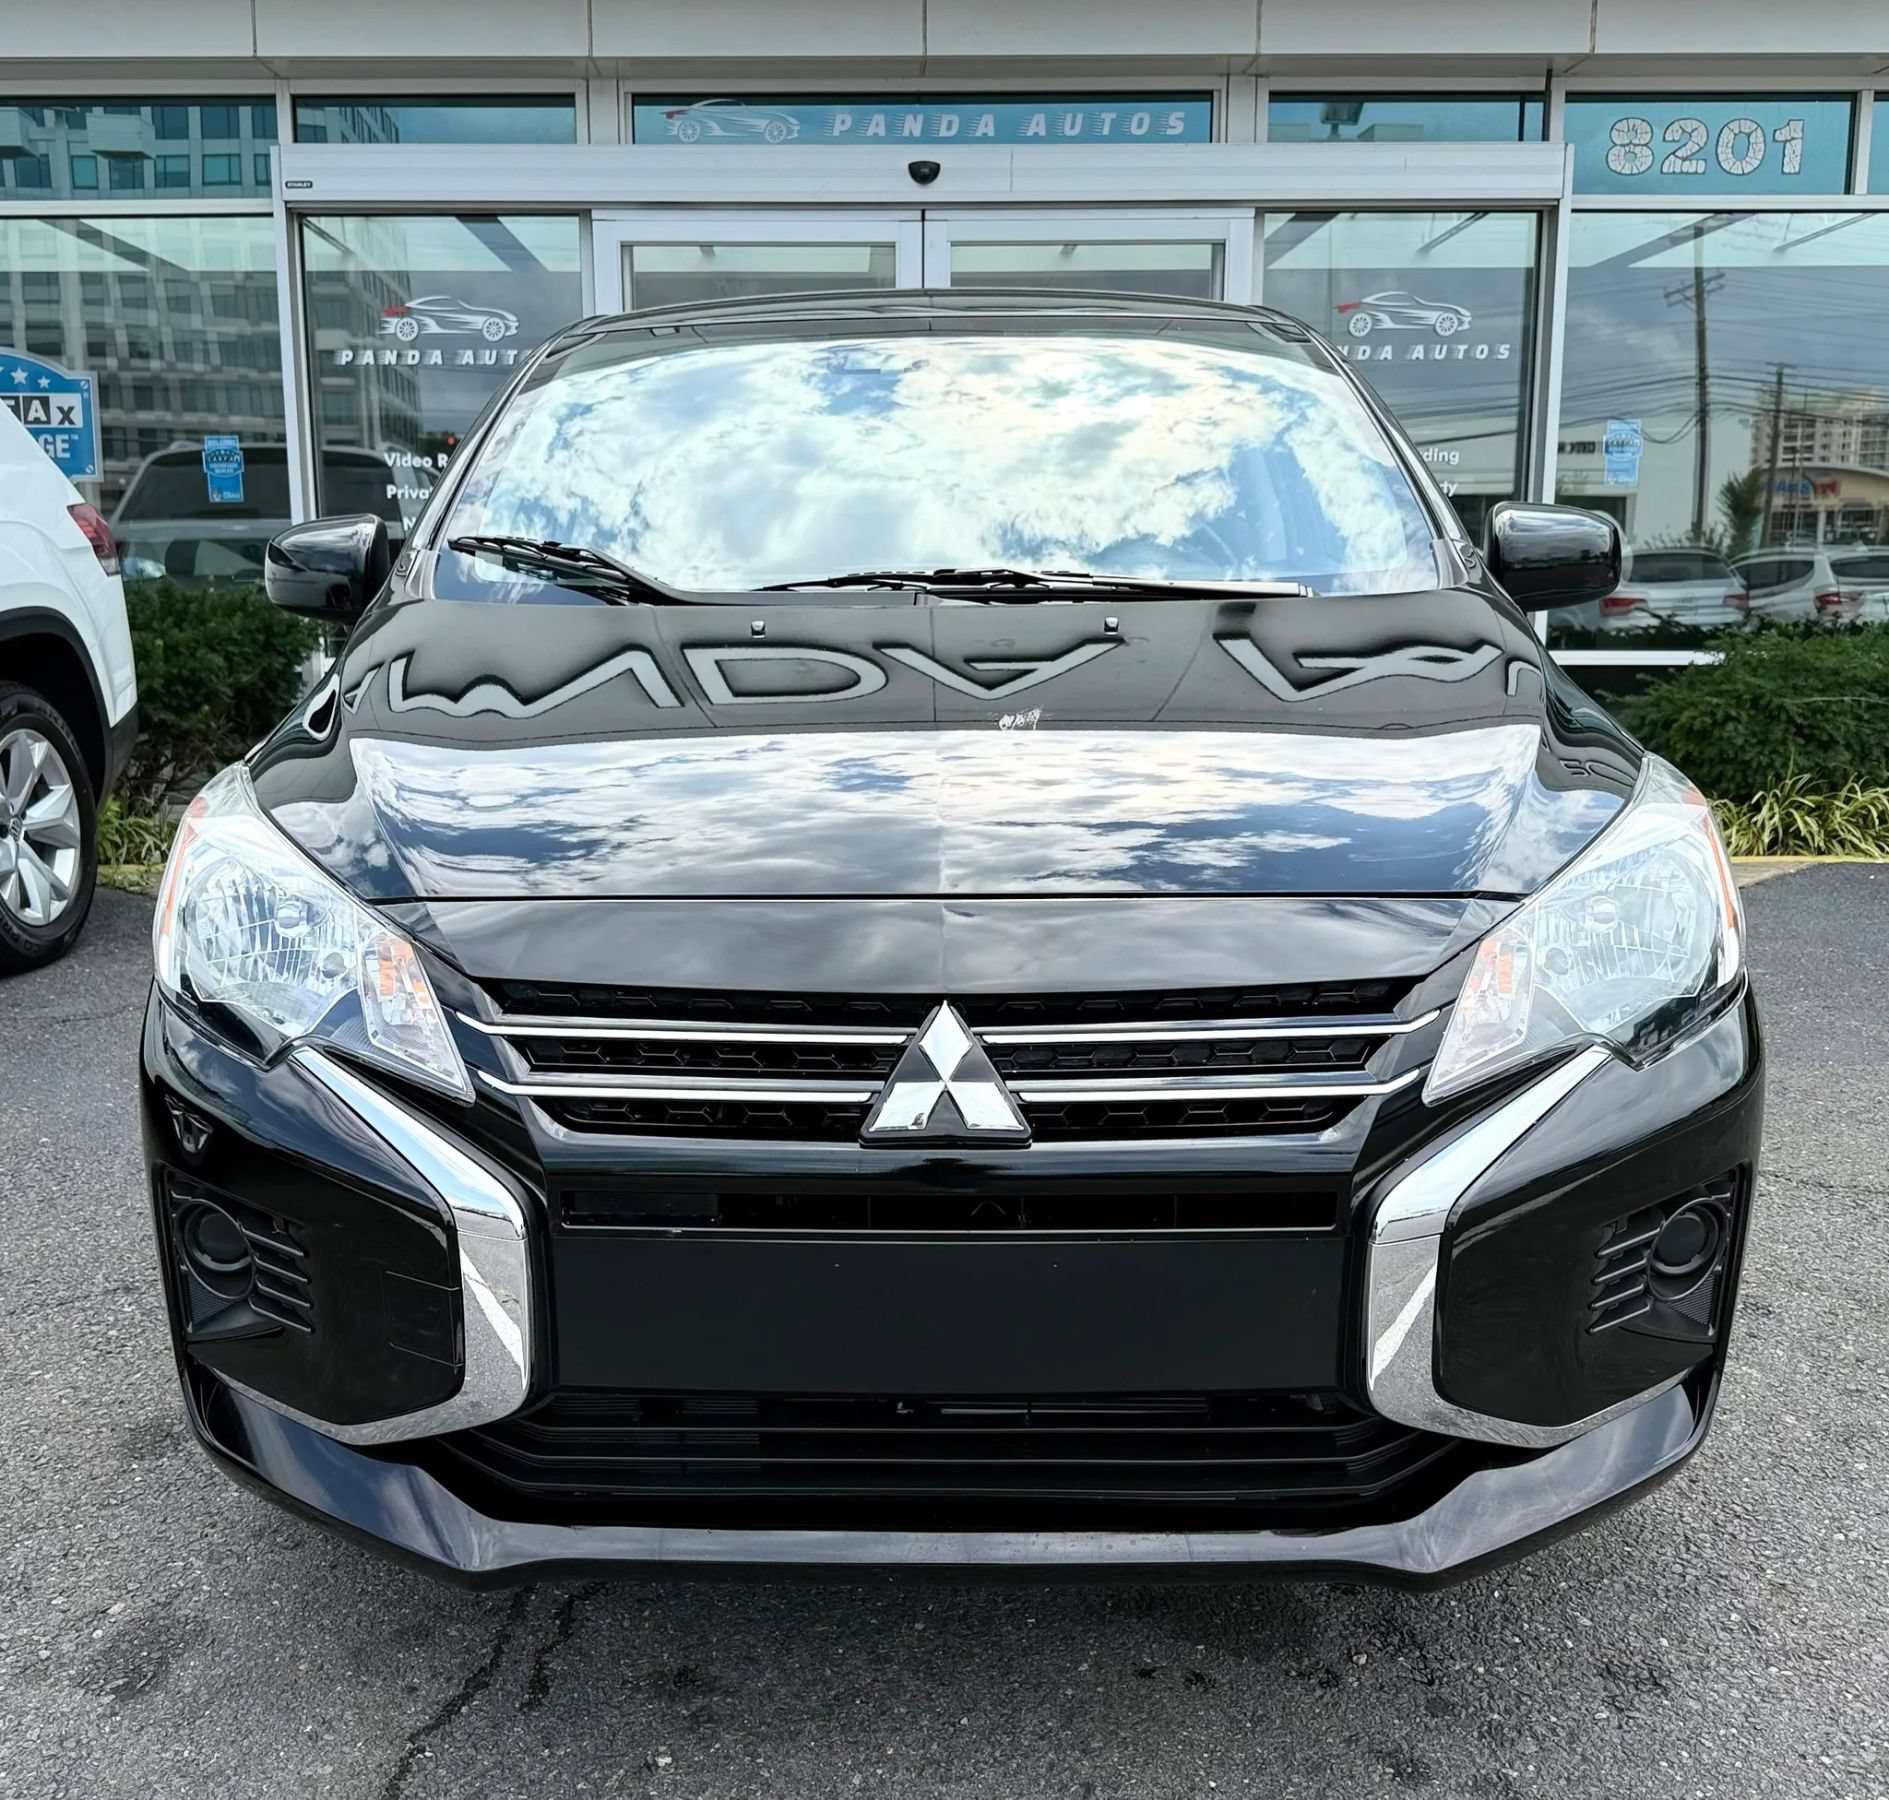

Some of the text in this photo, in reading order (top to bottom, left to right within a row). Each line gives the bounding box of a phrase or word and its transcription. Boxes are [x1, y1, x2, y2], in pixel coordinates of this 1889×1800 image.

[828, 111, 1186, 137] PANDA AUTOS
[1605, 117, 1805, 176] 8201
[338, 349, 518, 366] PANDA AUT
[1409, 343, 1511, 361] AUTOS
[383, 452, 433, 468] Video
[1420, 447, 1460, 465] ding
